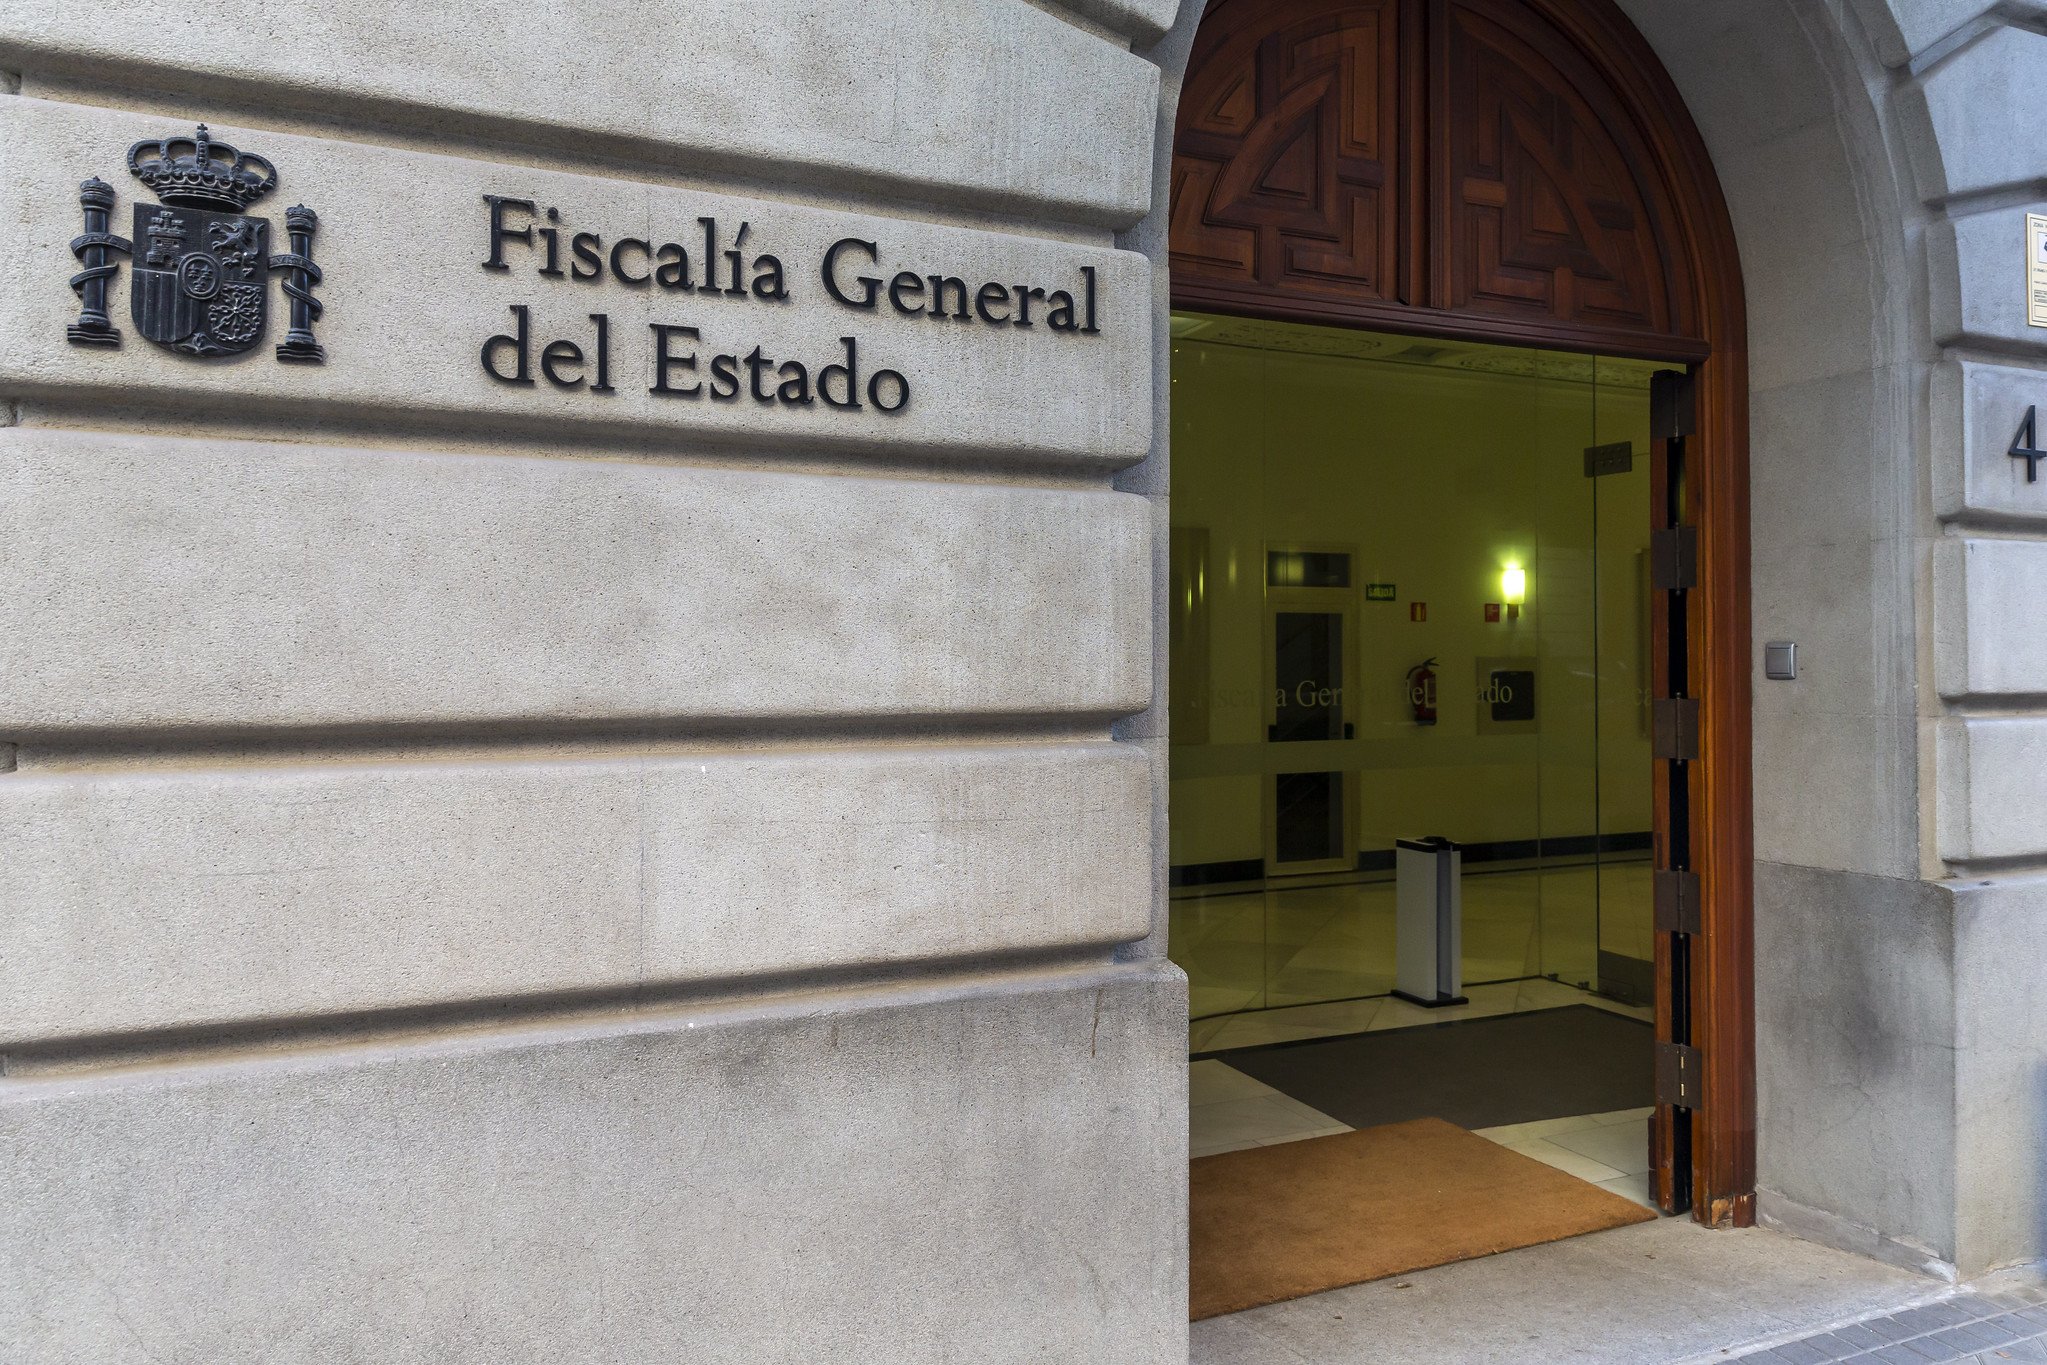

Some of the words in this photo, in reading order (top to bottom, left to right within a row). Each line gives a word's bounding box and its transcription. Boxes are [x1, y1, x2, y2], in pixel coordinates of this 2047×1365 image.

[482, 194, 790, 303] Fiscalía
[821, 237, 1101, 337] General
[481, 304, 615, 395] del
[649, 323, 910, 415] Estado
[2007, 404, 2047, 483] 4
